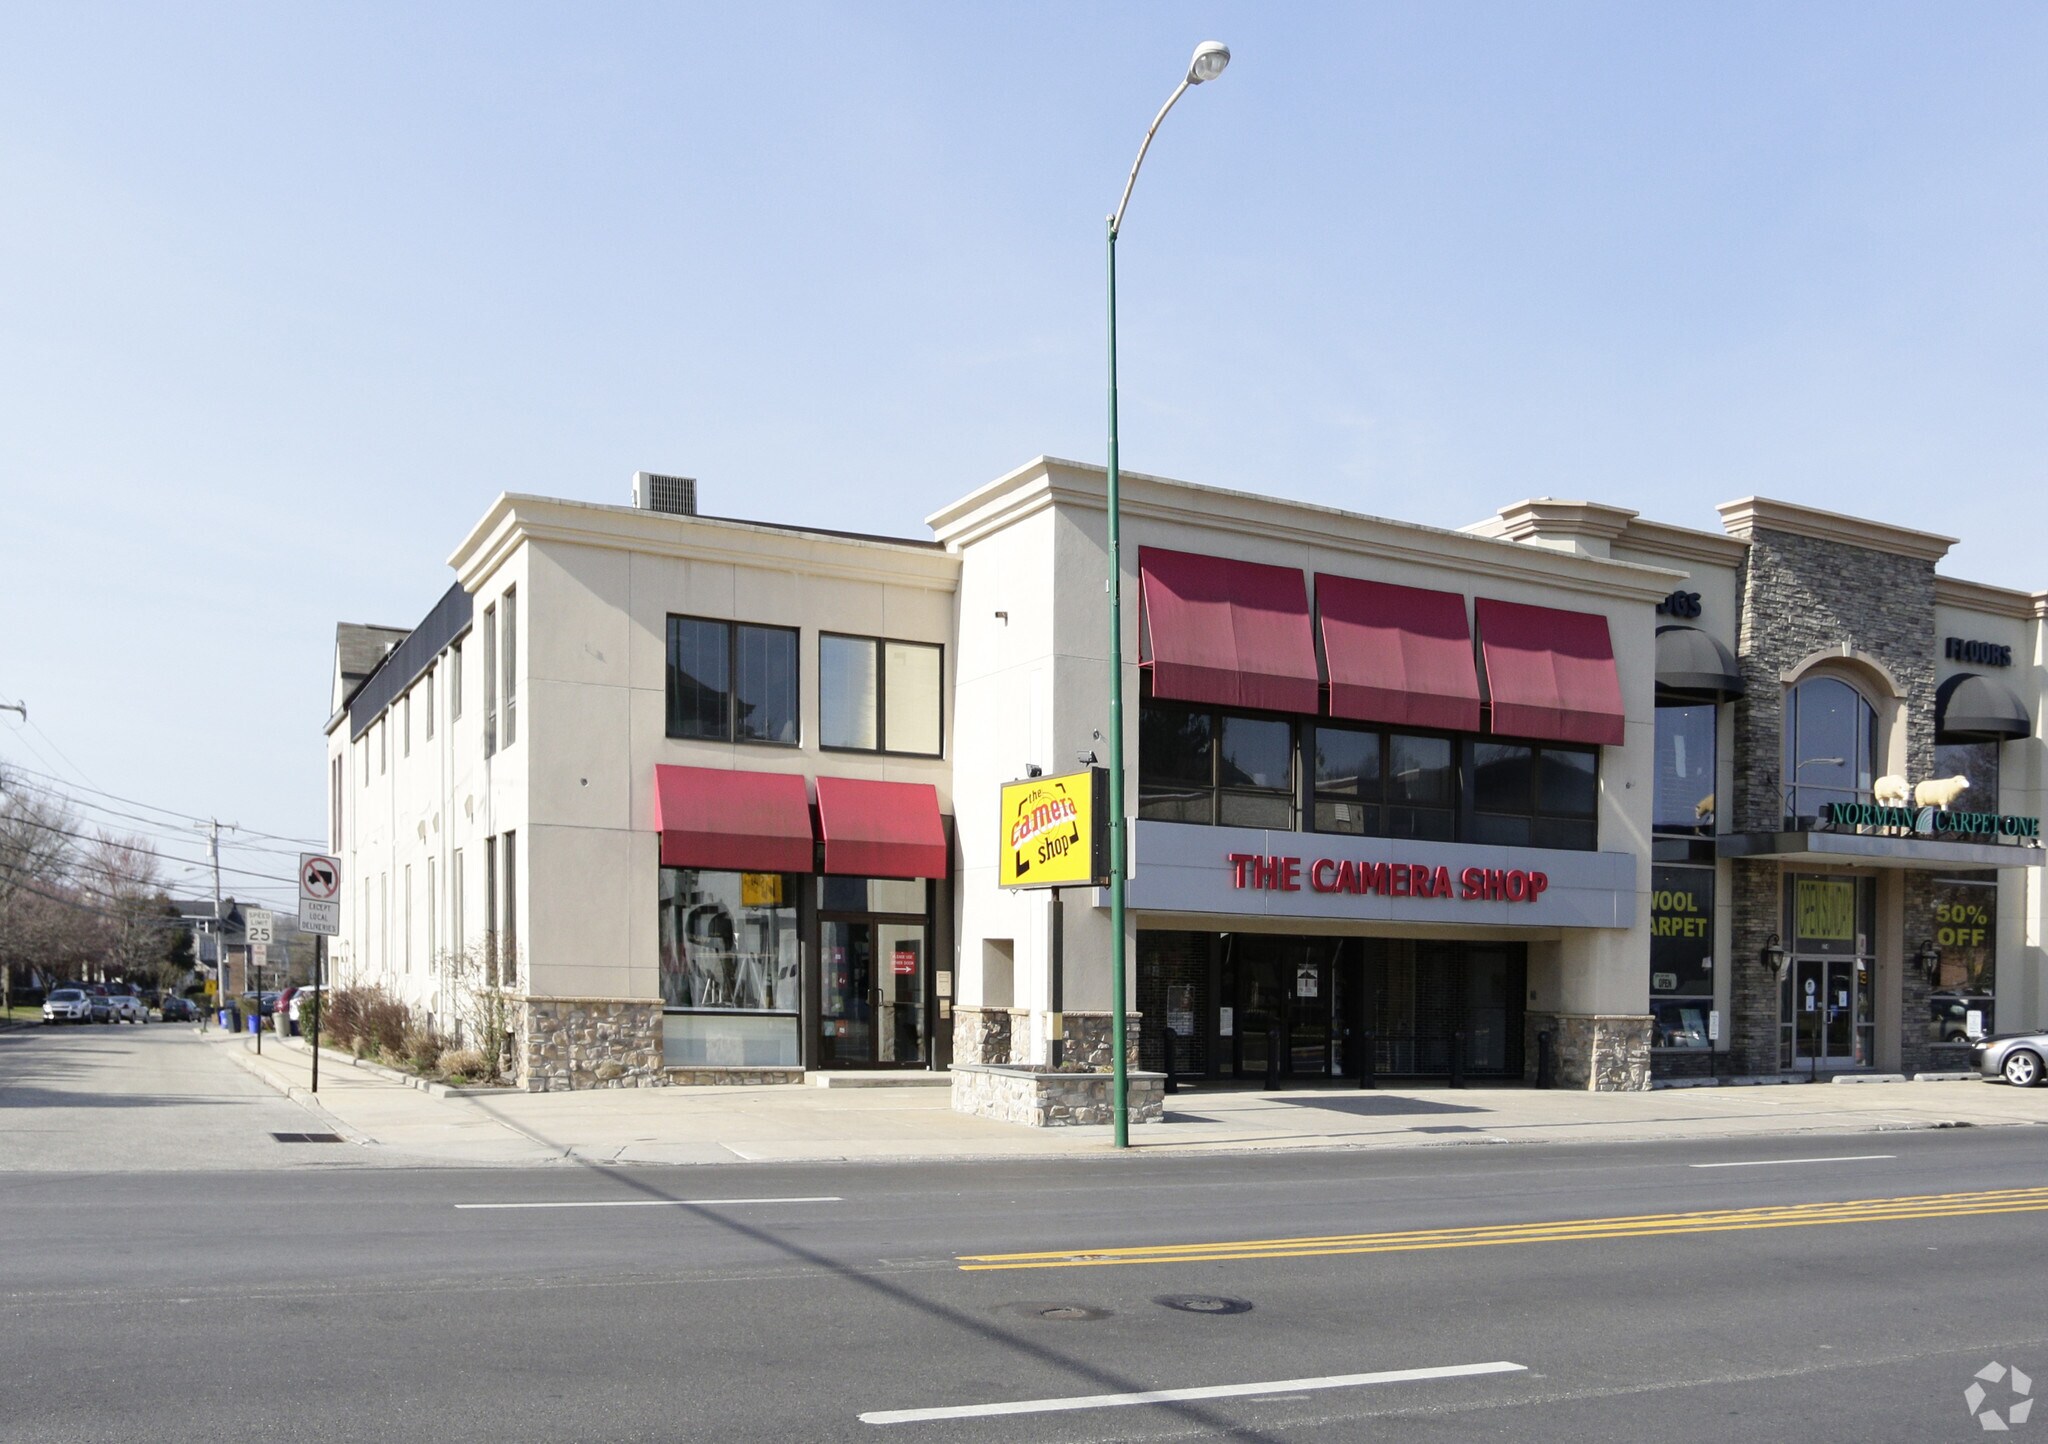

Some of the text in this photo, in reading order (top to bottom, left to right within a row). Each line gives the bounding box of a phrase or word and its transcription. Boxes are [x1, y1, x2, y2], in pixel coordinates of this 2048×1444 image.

[1945, 637, 2012, 667] FLOORS
[1028, 789, 1042, 804] the
[1011, 797, 1078, 848] camera
[1830, 802, 2041, 838] NORMAN CARPET ONE
[1038, 835, 1069, 865] shop
[1228, 853, 1549, 903] THE CAMERA SHOP
[249, 911, 270, 919] SPEED
[309, 903, 331, 911] EXCEPT
[309, 913, 328, 921] LOCAL
[1936, 904, 1988, 925] 50%
[249, 928, 270, 941] 25
[302, 921, 336, 932] DELIVERIES
[1651, 916, 1707, 938] ARPET
[1937, 927, 1985, 946] OFF
